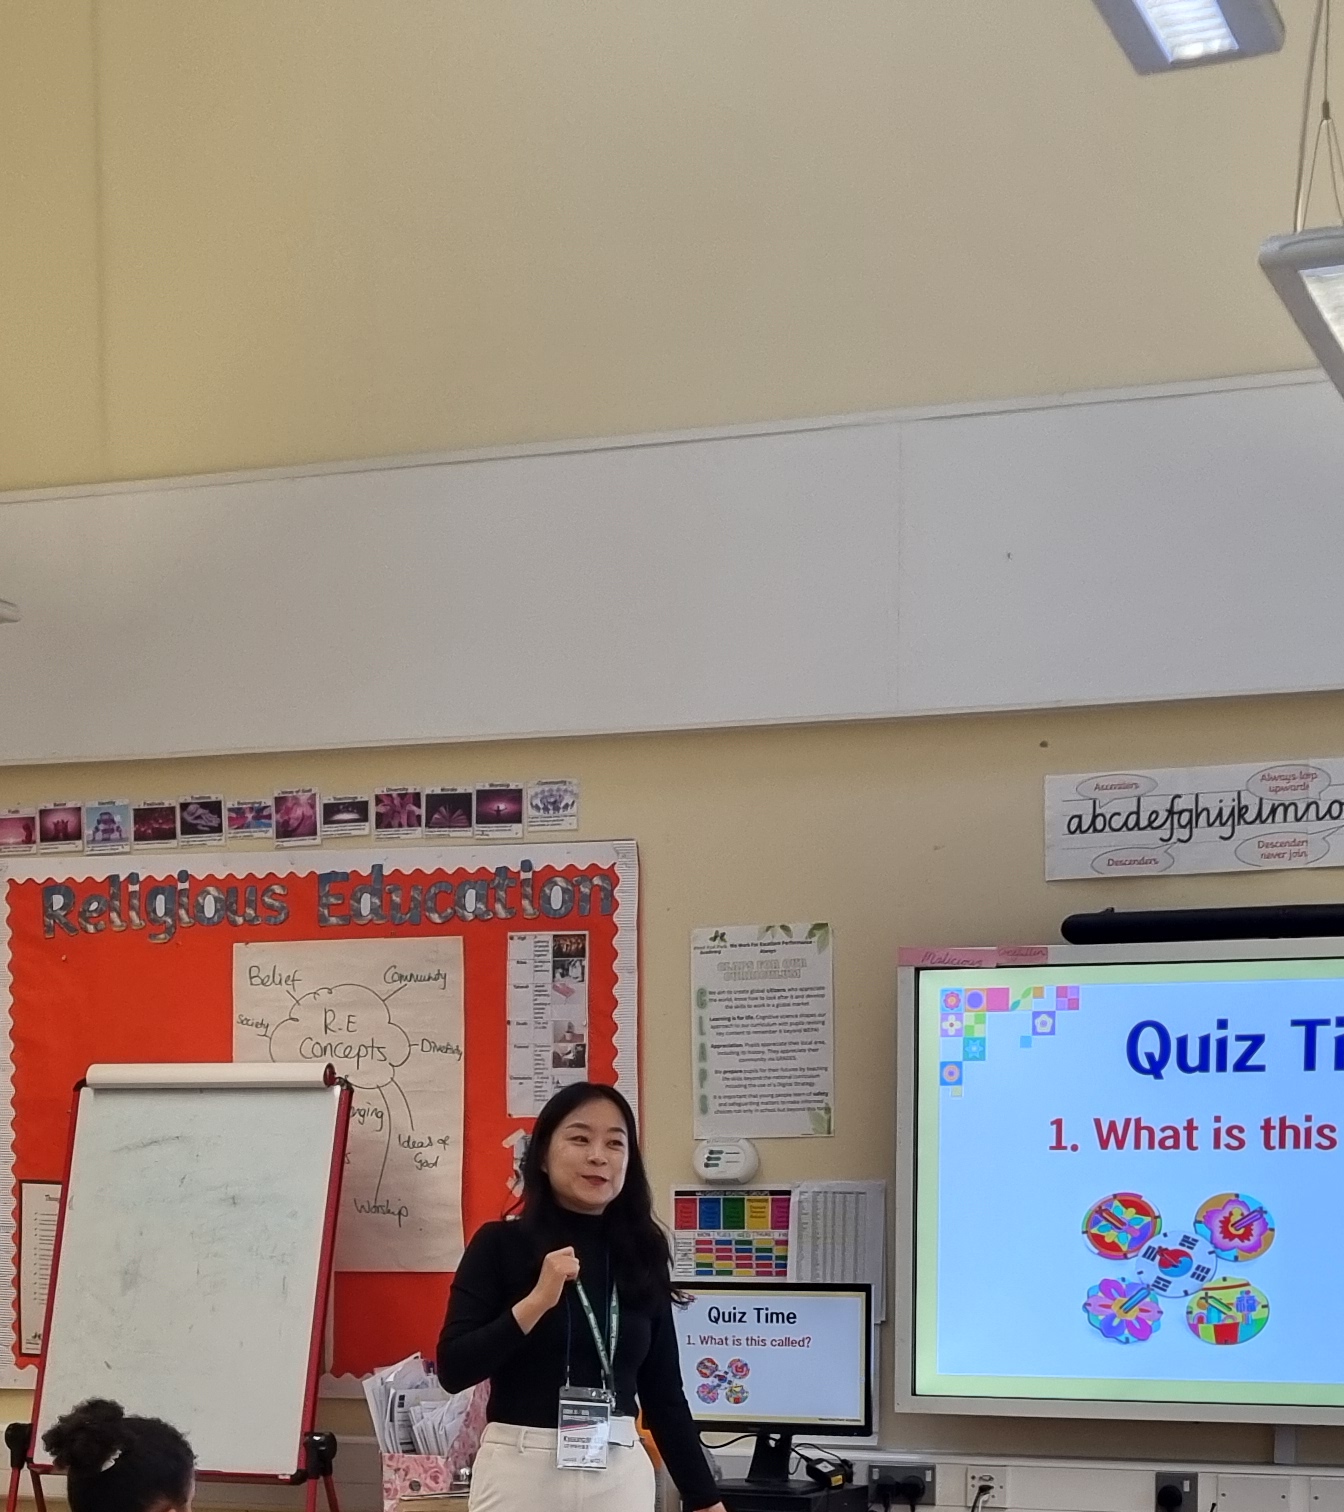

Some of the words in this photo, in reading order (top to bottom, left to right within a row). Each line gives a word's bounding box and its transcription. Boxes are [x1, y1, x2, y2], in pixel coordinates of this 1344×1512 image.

[1260, 770, 1296, 783] Always
[1260, 851, 1286, 859] never
[43, 869, 290, 943] Religious
[317, 859, 614, 927] Education
[921, 951, 983, 966] Malicious
[248, 964, 304, 990] Belief
[299, 1036, 388, 1071] Concepts
[1125, 1019, 1266, 1080] Quiz
[397, 1134, 434, 1149] Ideas
[1048, 1119, 1081, 1153] 1.
[1094, 1116, 1199, 1152] What
[1212, 1115, 1246, 1151] is
[1260, 1114, 1338, 1151] this
[413, 1153, 440, 1170] God
[353, 1198, 410, 1228] Worship
[707, 1306, 747, 1324] Quiz
[754, 1306, 798, 1324] Time
[686, 1335, 696, 1346] 1.
[699, 1334, 730, 1347] What
[732, 1335, 742, 1347] is
[745, 1334, 768, 1347] this
[771, 1335, 812, 1348] called?
